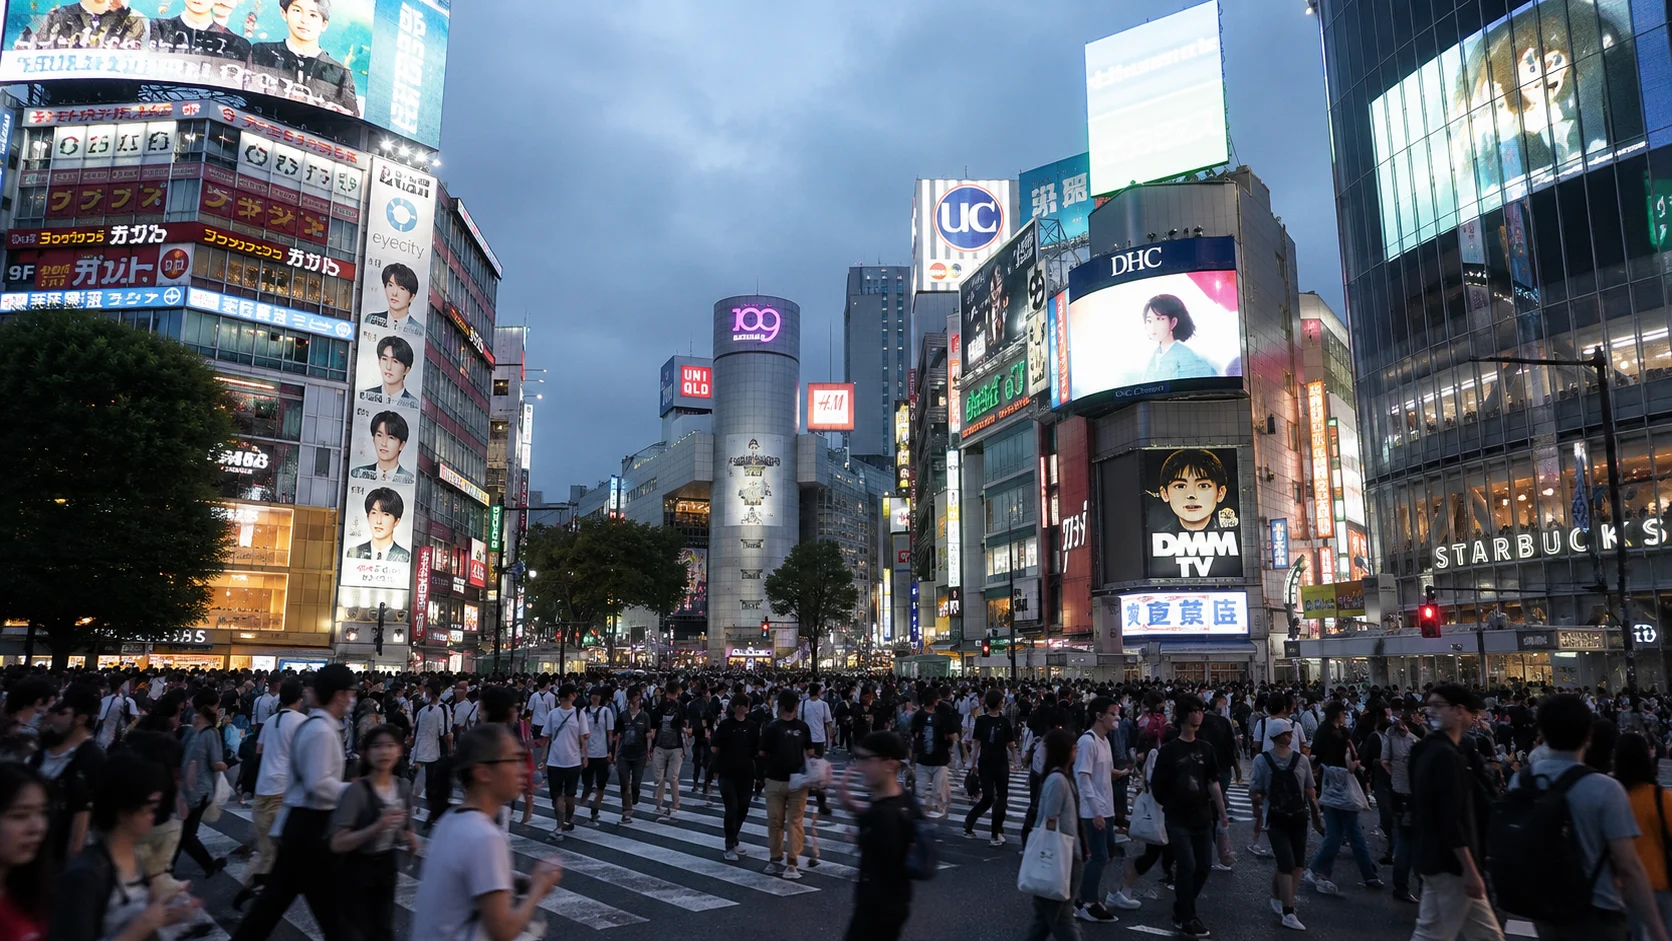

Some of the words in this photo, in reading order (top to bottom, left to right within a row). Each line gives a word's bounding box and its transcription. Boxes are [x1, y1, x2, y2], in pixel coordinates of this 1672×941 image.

[372, 232, 425, 259] eyecity
[8, 265, 36, 281] 9F
[1111, 246, 1163, 277] DHC
[731, 306, 782, 343] 109
[684, 369, 707, 382] UNI
[684, 382, 709, 395] QLO
[1152, 531, 1239, 557] DMM
[1435, 518, 1668, 569] STARBUCKS
[1176, 556, 1214, 578] TV
